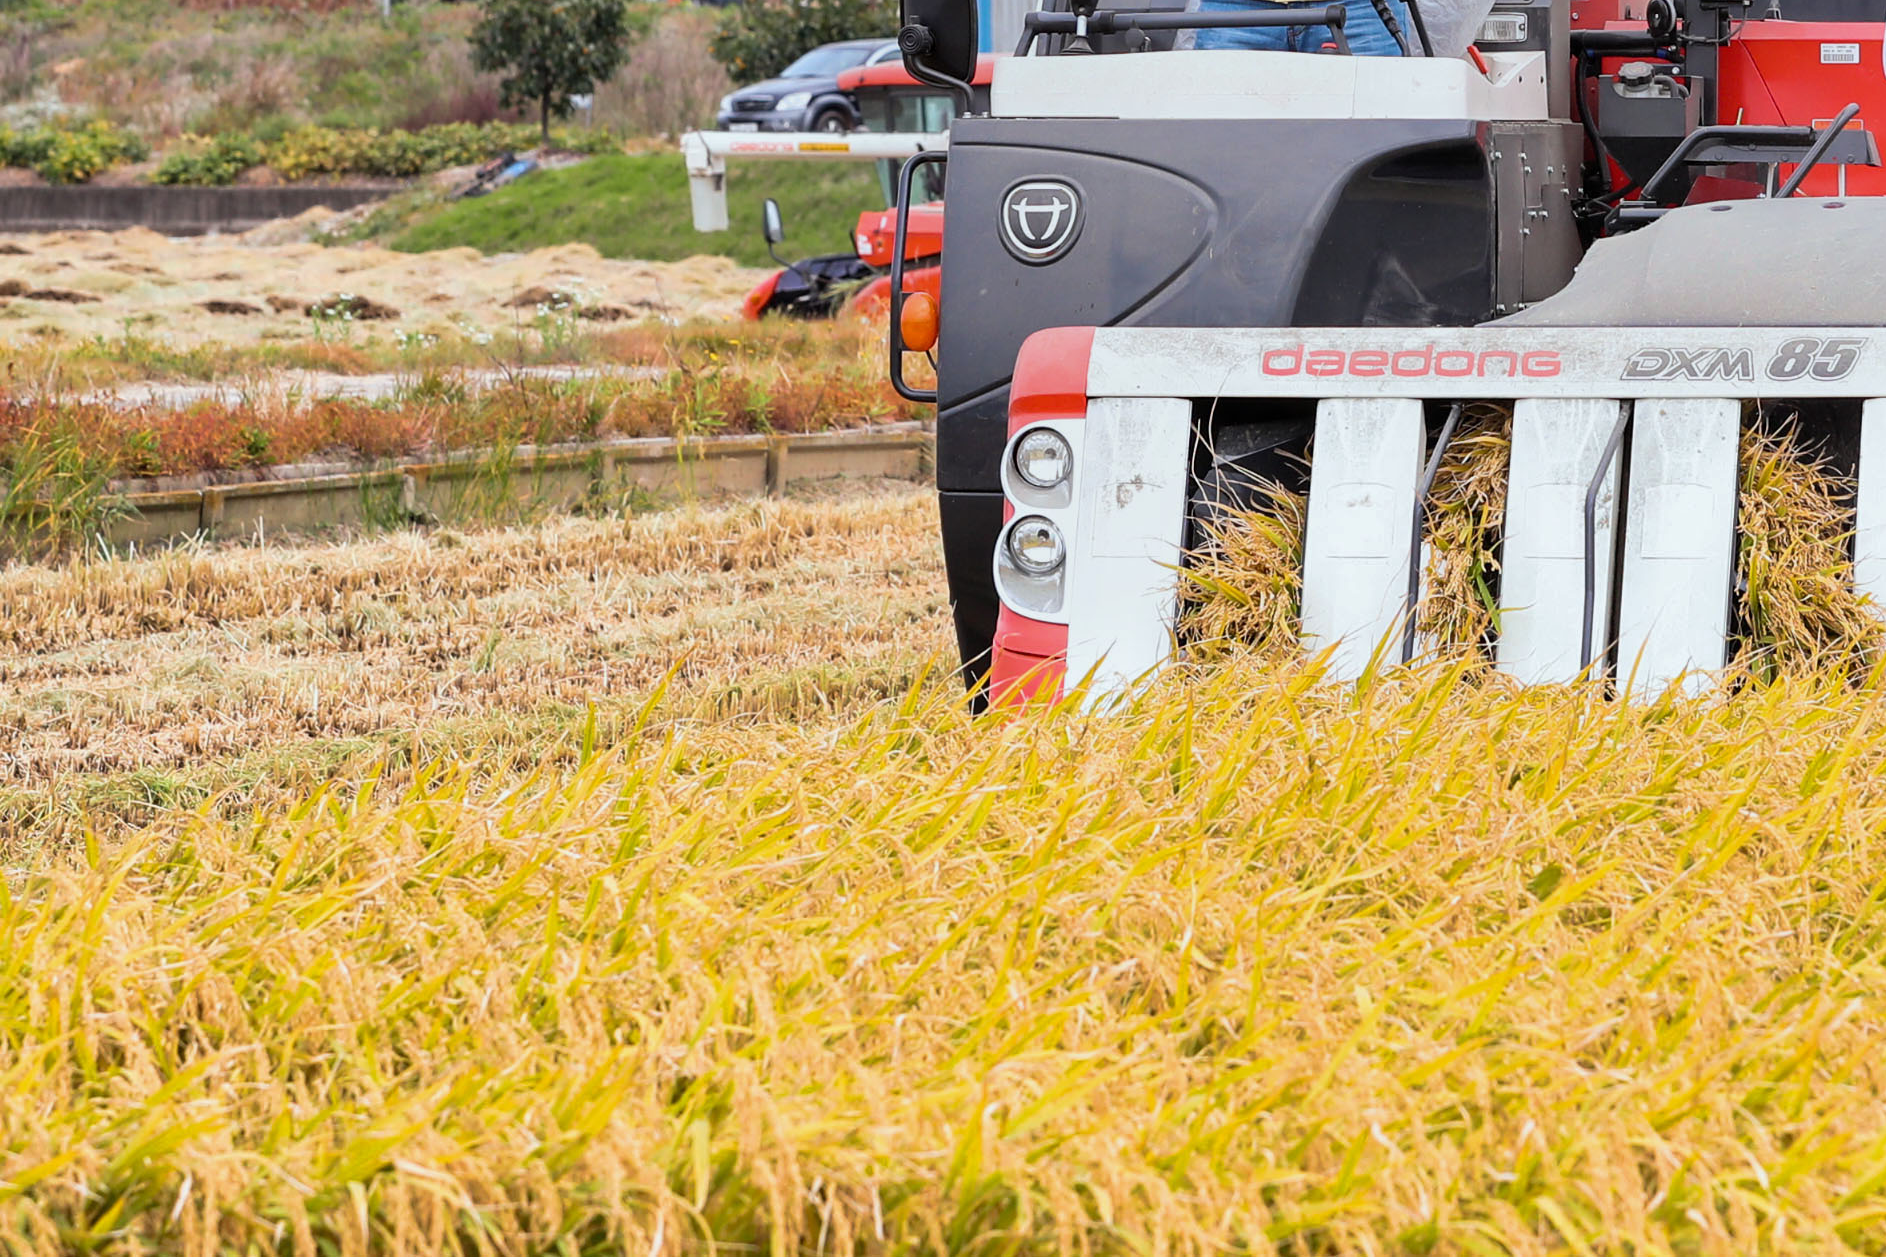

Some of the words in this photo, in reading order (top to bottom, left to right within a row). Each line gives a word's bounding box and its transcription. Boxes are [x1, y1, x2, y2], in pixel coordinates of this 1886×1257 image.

[1262, 343, 1561, 378] daedong
[1620, 347, 1755, 381] DXM
[1765, 337, 1868, 381] 85
